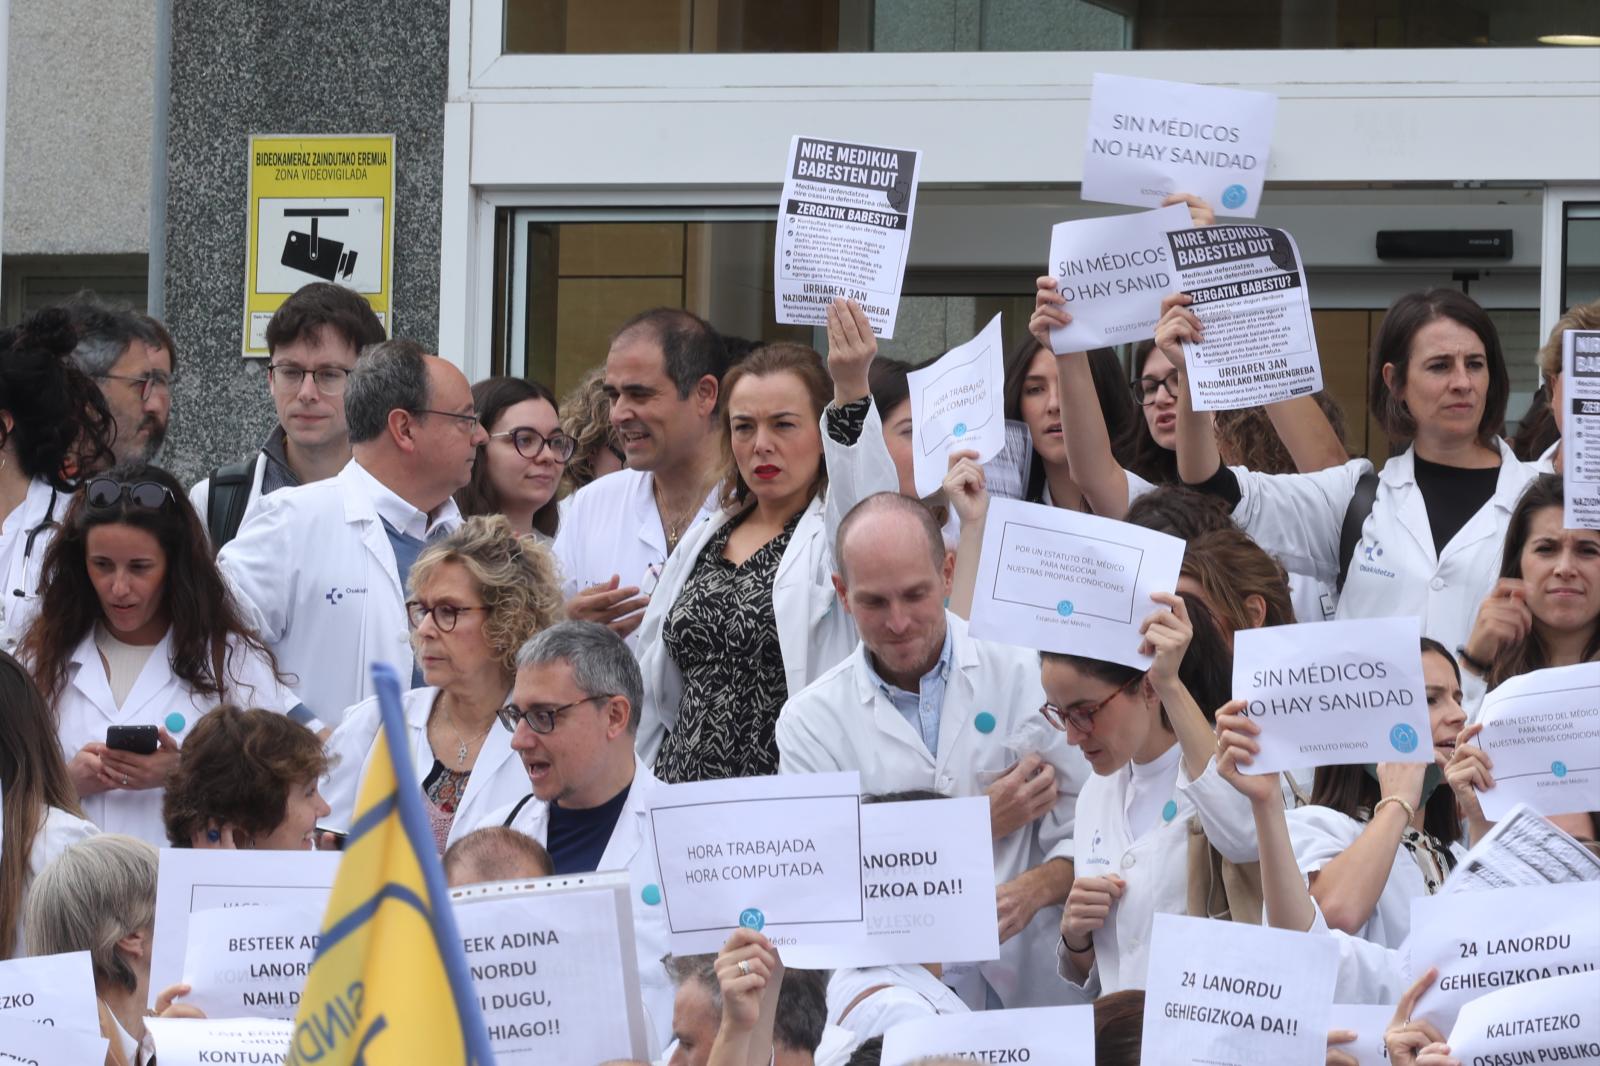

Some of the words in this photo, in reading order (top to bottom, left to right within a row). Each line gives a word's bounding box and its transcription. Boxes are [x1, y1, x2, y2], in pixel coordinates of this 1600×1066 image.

[1113, 114, 1144, 132] SIN
[1150, 117, 1240, 143] MÉDICOS
[256, 152, 311, 167] BIDEOKAMERAZ
[312, 152, 356, 166] ZAINDUTAKO
[358, 152, 387, 166] EREMUA
[801, 142, 834, 161] NIRE
[837, 146, 898, 169] MEDIKUA
[1092, 138, 1123, 156] NO
[1127, 142, 1167, 162] HAY
[1170, 147, 1257, 170] SANIDAD
[275, 168, 299, 180] ZONA
[302, 168, 368, 180] VIDEOVIGILADA
[798, 160, 868, 184] BABESTEN
[871, 170, 898, 188] DUT
[797, 202, 845, 220] ZERGATIK
[847, 208, 898, 226] BABESTU?
[1172, 231, 1206, 248] NIRE
[1206, 226, 1269, 242] MEDIKUA
[1059, 260, 1084, 277] SIN
[1086, 246, 1167, 273] MÉDICOS
[1178, 242, 1247, 265] BABESTEN
[1248, 238, 1274, 254] DUT
[1214, 263, 1254, 273] defendatzea
[804, 284, 846, 296] URRIAREN
[848, 289, 867, 301] 3AN
[1056, 287, 1075, 302] O
[1078, 281, 1111, 300] HAY
[1116, 273, 1170, 294] SANID
[1191, 284, 1240, 304] ZERGATIK
[1241, 276, 1291, 296] BABESTU?
[783, 294, 832, 305] NAZIOMAILAKO
[1219, 363, 1265, 378] URRIAREN
[1268, 358, 1288, 371] 3AN
[1198, 376, 1252, 389] NAZIOMAILAKO
[1015, 544, 1031, 553] POR
[1032, 548, 1042, 556] UN
[1044, 550, 1080, 564] ESTATUTO
[1081, 557, 1094, 567] DEL
[1096, 559, 1125, 572] MÉDICO
[1040, 560, 1059, 569] PARA
[1060, 563, 1097, 576] NEGOCIAR
[1006, 564, 1043, 576] NUESTRAS
[1045, 570, 1074, 583] PROPIAS
[1076, 575, 1124, 593] CONDICIONES
[1252, 669, 1282, 688] SIN
[1289, 662, 1387, 685] MÉDICOS
[1272, 697, 1313, 715] HAY
[1319, 689, 1413, 712] SANIDAD
[1490, 720, 1505, 728] POR
[1506, 718, 1516, 726] UN
[1518, 713, 1553, 724] ESTATUTO
[1570, 708, 1598, 718] MÉDICO
[1518, 725, 1536, 734] PARA
[1537, 722, 1574, 732] NEGOCIAR
[1300, 742, 1338, 753] ESTATUTO
[1340, 741, 1368, 750] PROPIO
[1490, 738, 1526, 749] NUESTRAS
[1527, 734, 1555, 744] PROPIAS
[688, 844, 722, 860] HORA
[726, 839, 816, 856] TRABAJADA
[686, 868, 718, 884] HORA
[722, 862, 824, 881] COMPUTADA
[924, 878, 962, 896] DA!!
[229, 936, 294, 951] BESTEEK
[501, 930, 559, 949] ADINA
[1460, 942, 1477, 958] 24
[1487, 934, 1571, 955] LANORDU
[1181, 971, 1196, 988] 24
[1202, 974, 1282, 1000] LANORDU
[1440, 966, 1552, 991] GEHIEGIZKOA
[244, 992, 284, 1006] NAHI
[492, 990, 552, 1010] DUGU,
[1165, 1002, 1255, 1030] GEHIEGIZKOA
[1261, 1016, 1298, 1037] DA!!
[1487, 1014, 1580, 1039] KALITATEZKO
[1473, 1050, 1536, 1066] OSASUN
